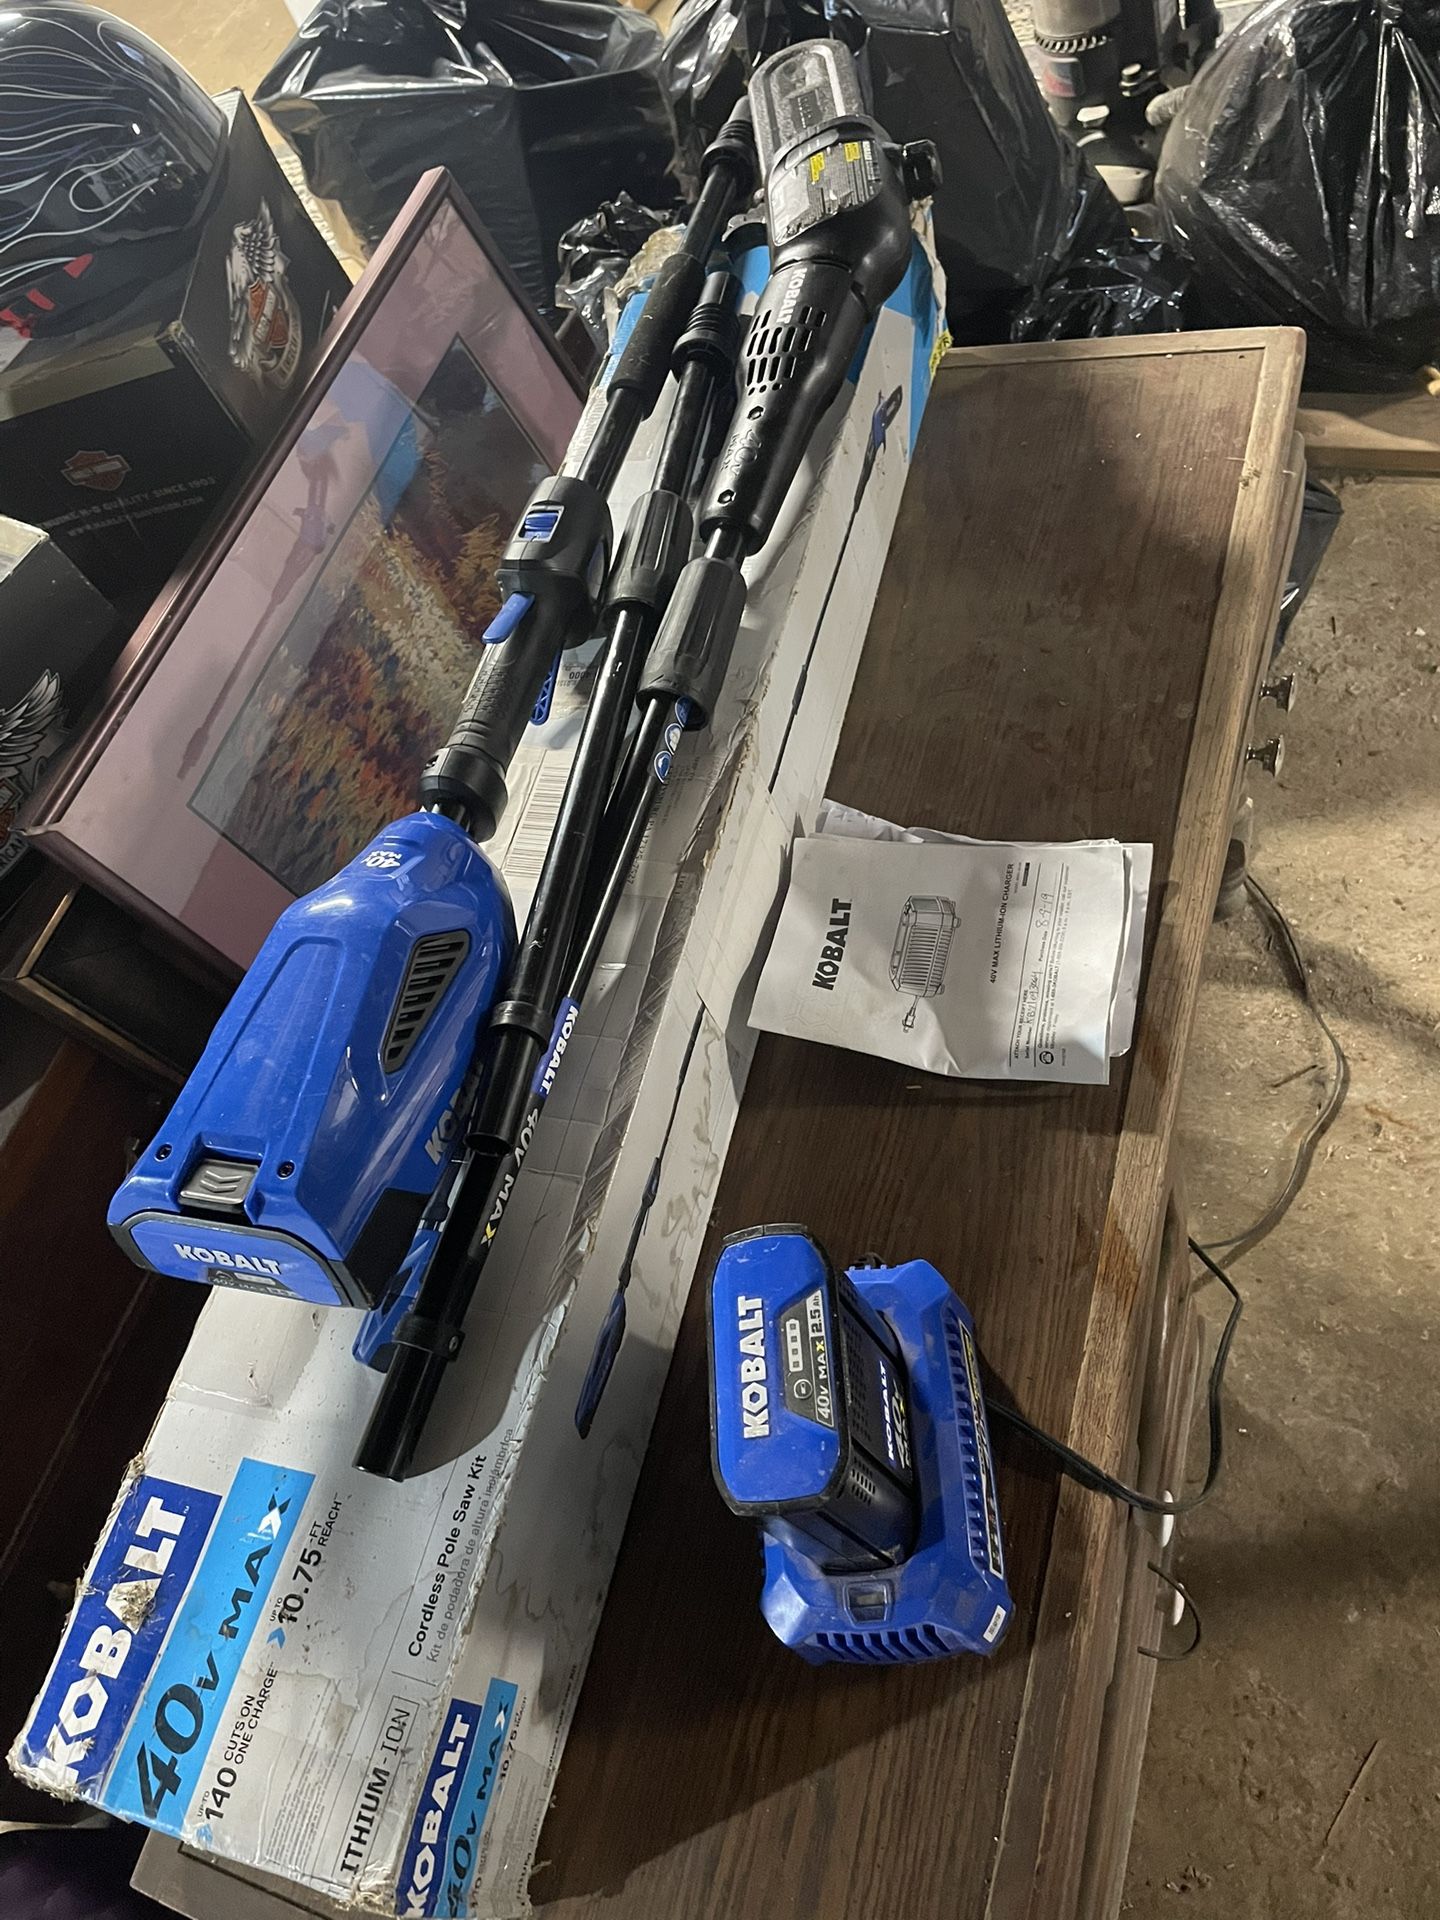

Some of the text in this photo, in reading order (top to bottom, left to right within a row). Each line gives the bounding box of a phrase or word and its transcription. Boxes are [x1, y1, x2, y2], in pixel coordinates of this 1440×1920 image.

[777, 268, 807, 324] KOBALT
[812, 897, 852, 990] KOBALT
[990, 863, 1014, 984] 40V MAX LITHIUM-ION CHARGER
[541, 1005, 579, 1095] KOBALT
[481, 1173, 515, 1248] MAX
[173, 1243, 281, 1275] KOBALT
[813, 1295, 820, 1307] Ah
[810, 1309, 822, 1334] 2.5
[816, 1340, 827, 1380] MAX
[738, 1296, 769, 1439] KOBALT
[880, 1360, 894, 1461] KOBALT
[219, 1493, 291, 1640] MAX
[317, 1501, 342, 1546] REACH
[408, 1454, 487, 1657] Cordless Pole Saw Kit
[269, 1597, 283, 1622] UP TO
[278, 1548, 322, 1623] 10.75
[426, 1643, 442, 1662] Kit
[438, 1623, 449, 1641] de
[445, 1558, 471, 1620] podadora
[465, 1539, 476, 1556] de
[472, 1500, 489, 1535] altura
[38, 1496, 186, 1788] KOBALT
[223, 1694, 255, 1762] CUTS ON
[234, 1669, 279, 1765] ONE CHARGE
[477, 1701, 509, 1800] MAX
[197, 1790, 210, 1818] UP TO
[204, 1767, 238, 1820] 140
[341, 1708, 410, 1880] ITHIUM-ION
[404, 1714, 470, 1918] KOBALT
